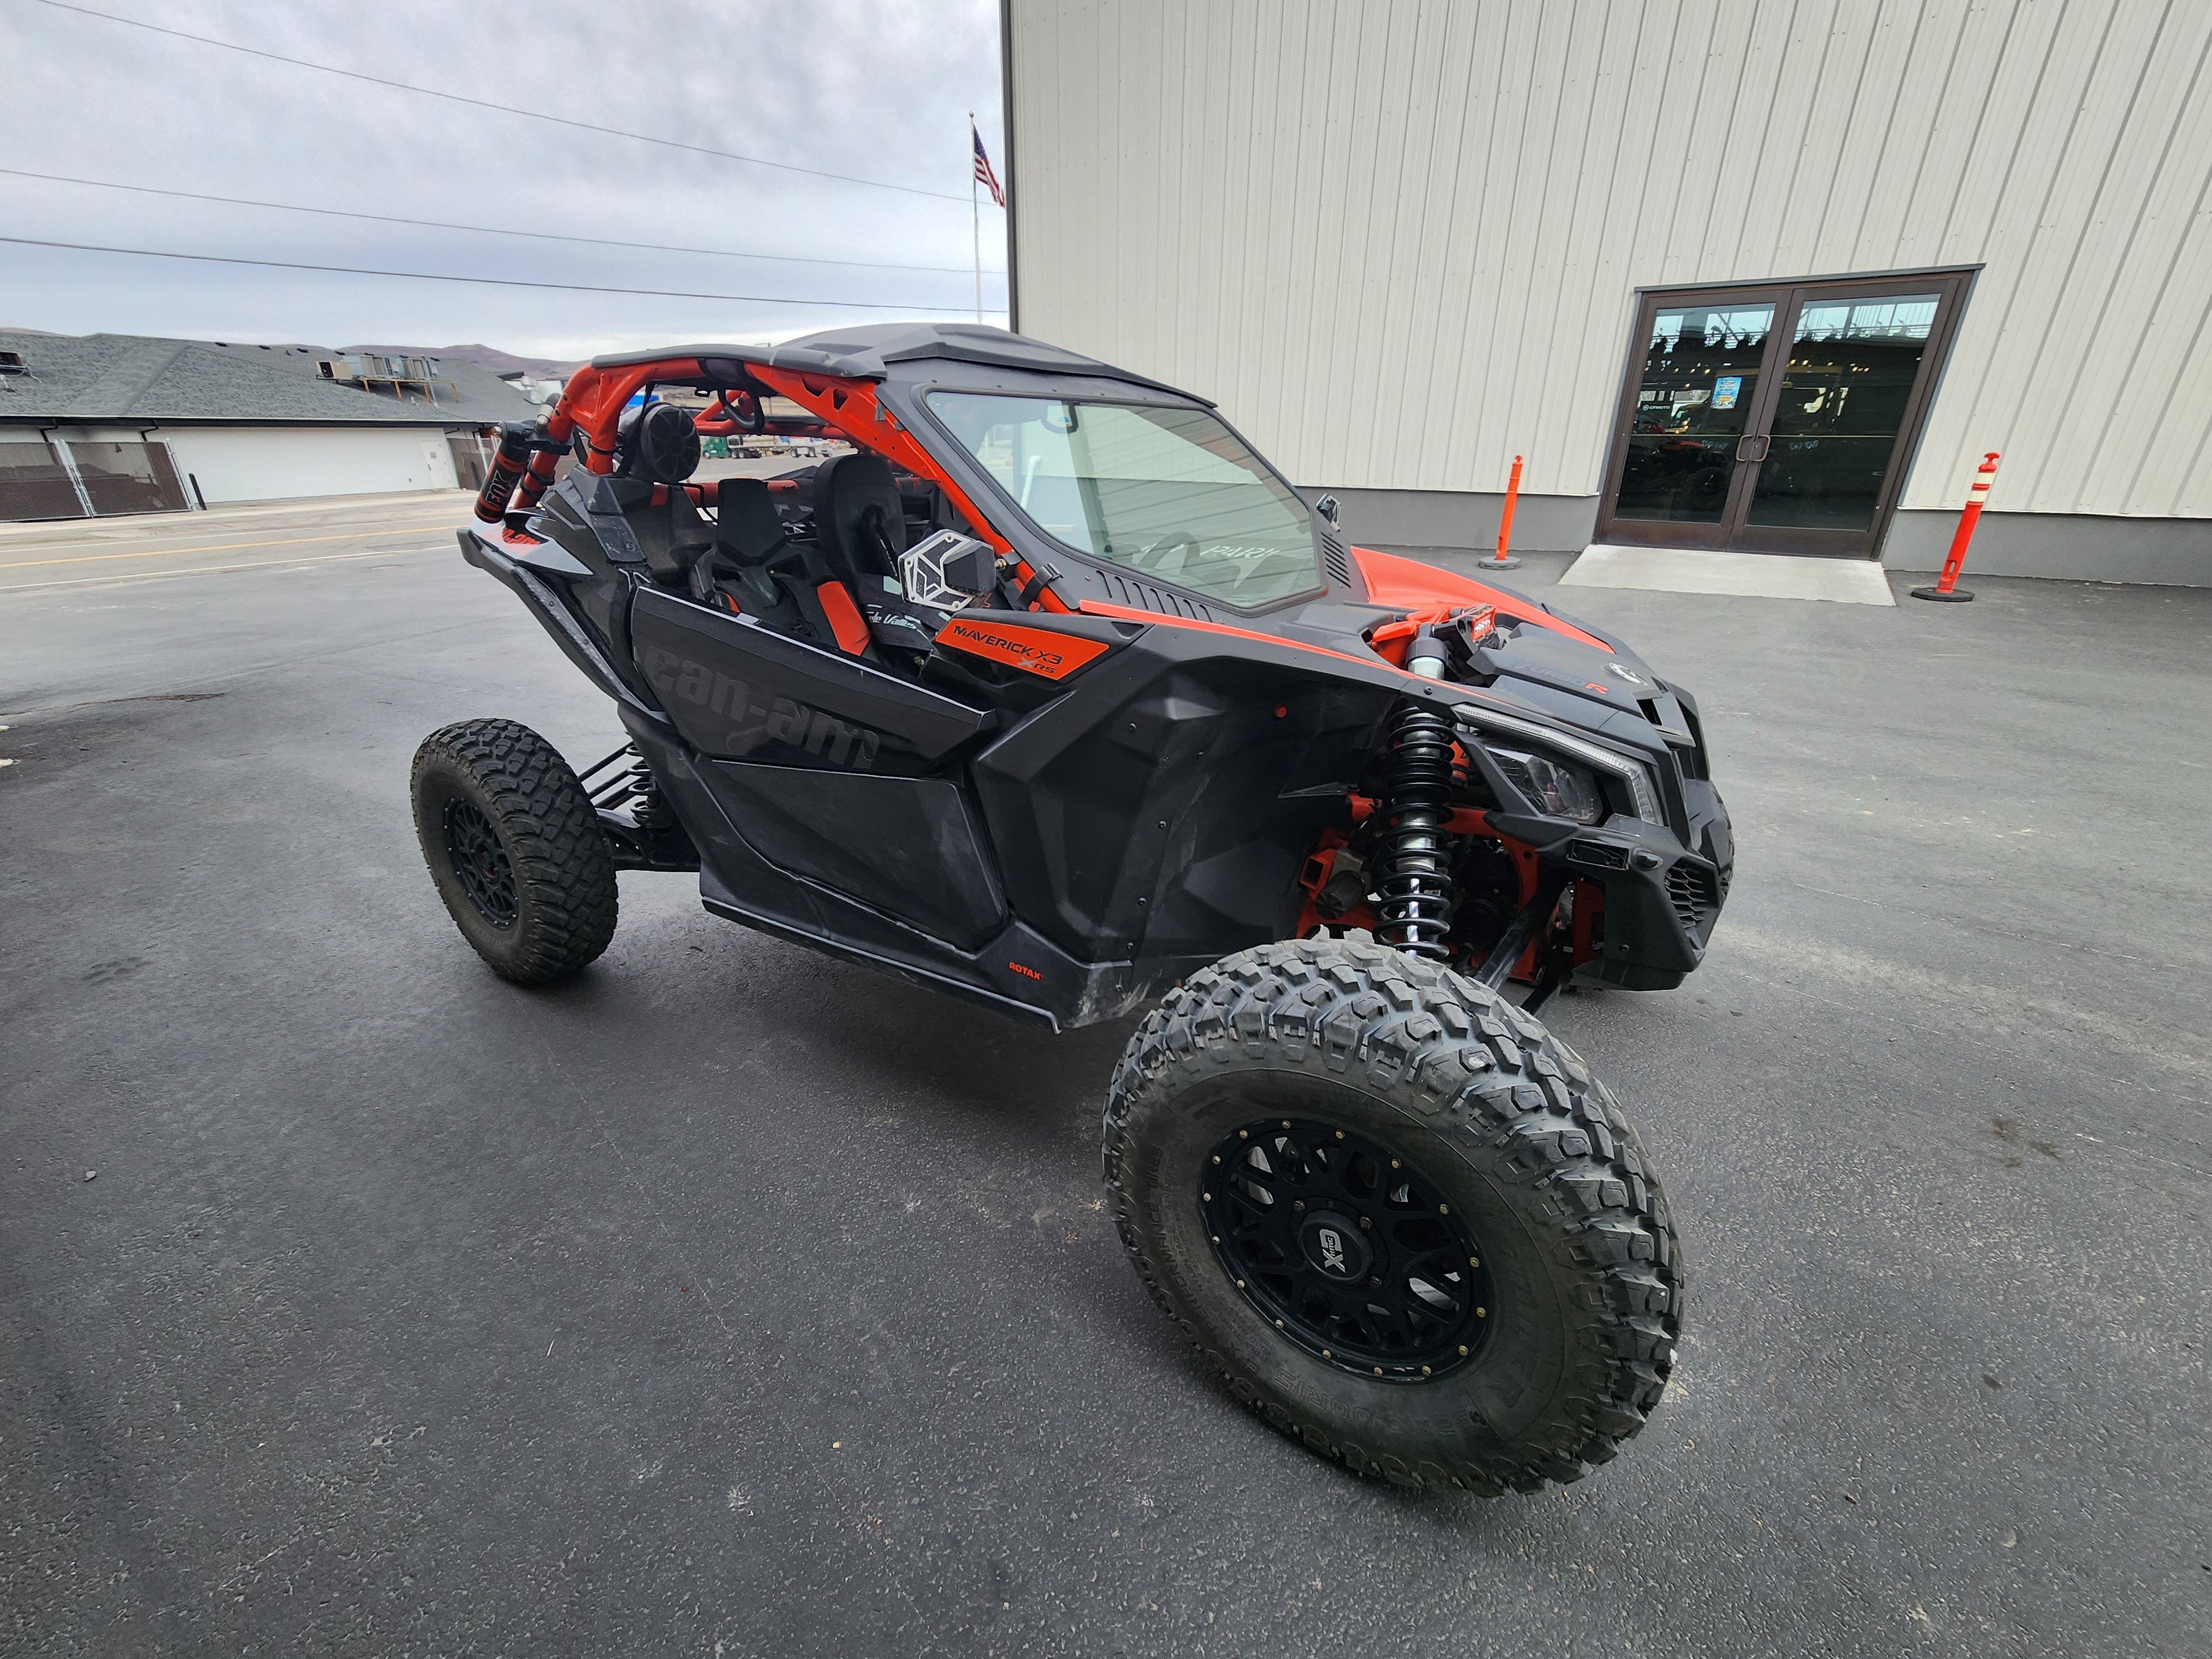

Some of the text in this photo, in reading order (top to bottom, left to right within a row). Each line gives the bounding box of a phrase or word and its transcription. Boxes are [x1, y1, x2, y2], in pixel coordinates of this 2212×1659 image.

[485, 469, 511, 507] FOX
[953, 625, 1063, 665] MAVERICK X3
[644, 645, 881, 769] can-am
[1008, 961, 1041, 981] ROTAX
[1146, 1144, 1163, 1192] TIRES
[1146, 1201, 1218, 1332] PERFORMANCE
[1319, 1229, 1346, 1274] XD
